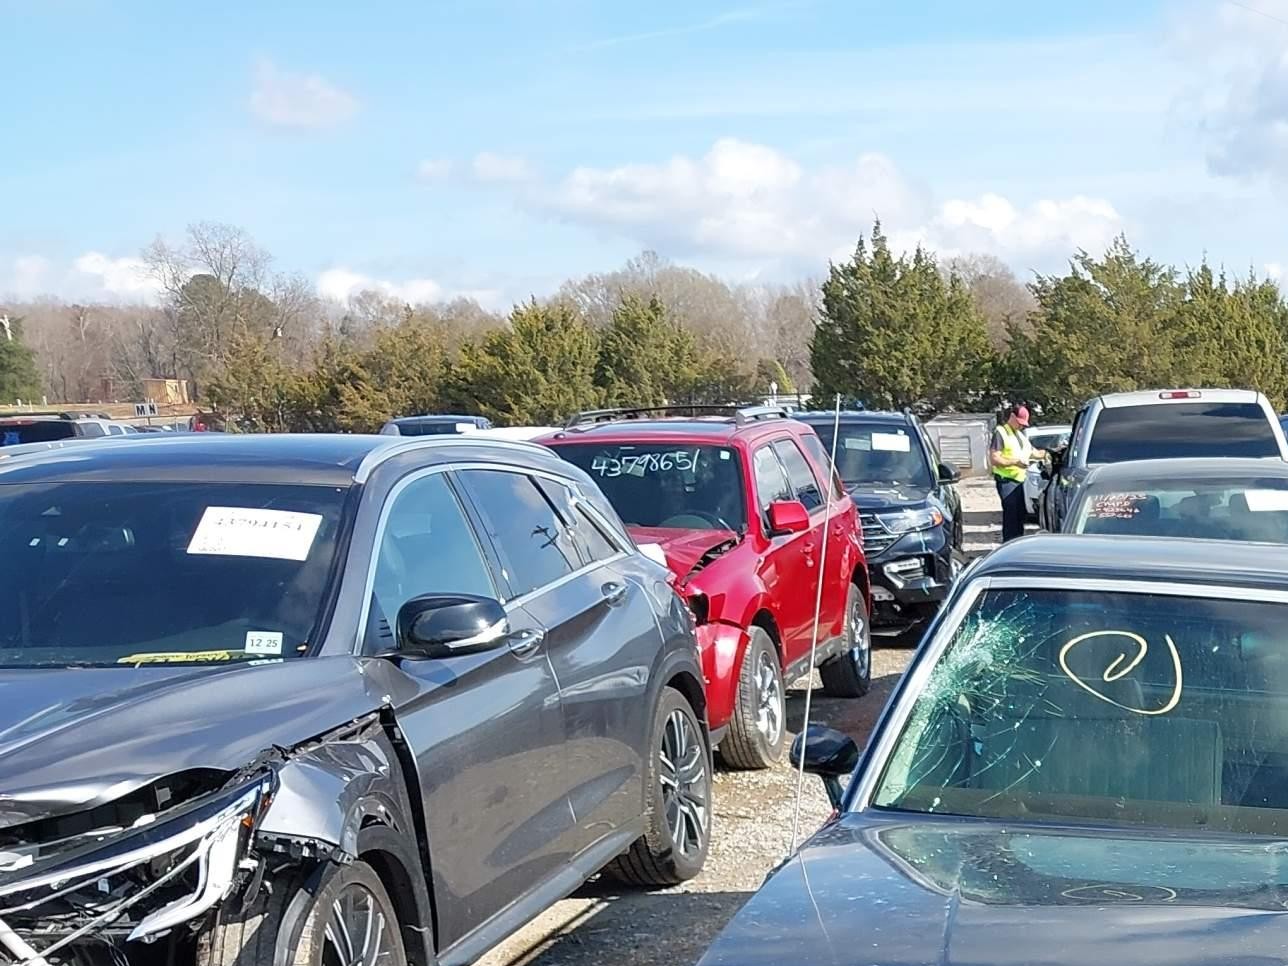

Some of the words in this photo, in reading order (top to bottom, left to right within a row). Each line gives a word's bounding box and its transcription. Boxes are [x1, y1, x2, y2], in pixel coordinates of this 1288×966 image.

[135, 405, 145, 416] M
[149, 404, 156, 414] N
[591, 449, 701, 477] 43798651
[249, 638, 262, 648] 12
[265, 639, 278, 648] 25
